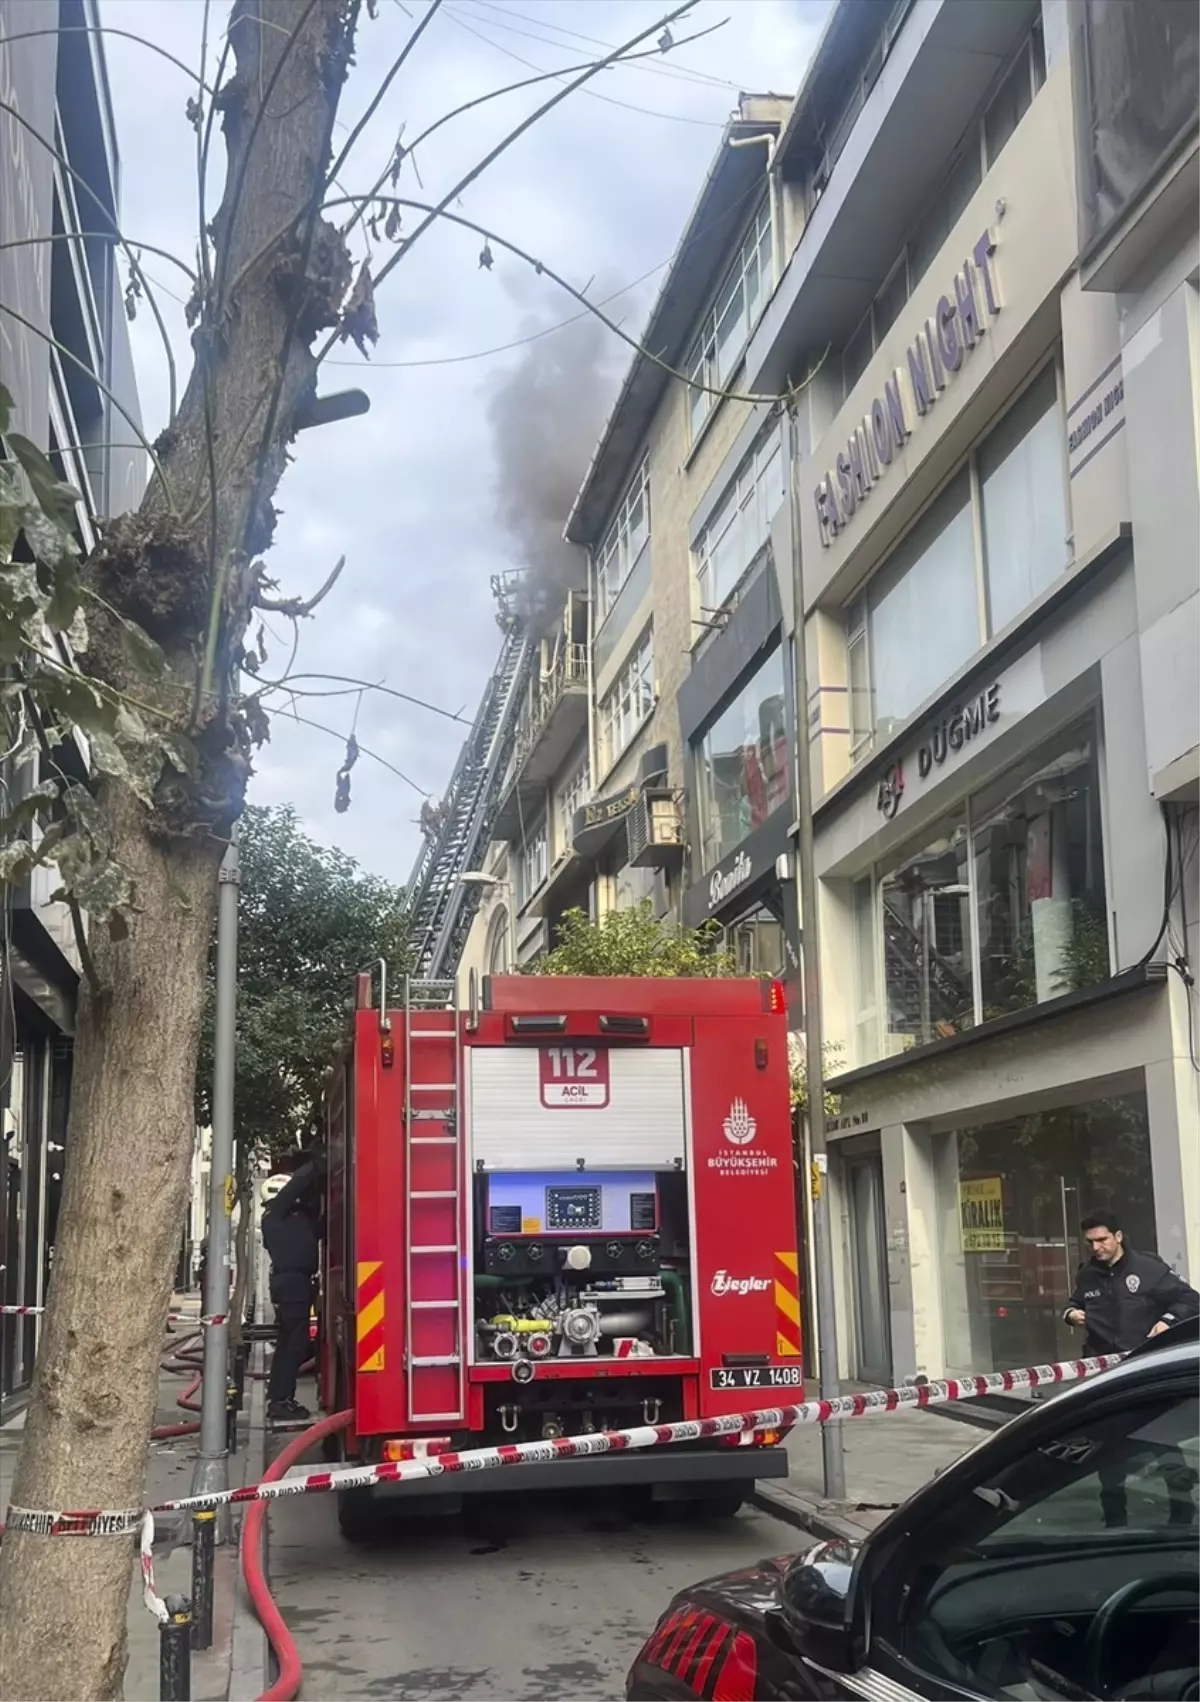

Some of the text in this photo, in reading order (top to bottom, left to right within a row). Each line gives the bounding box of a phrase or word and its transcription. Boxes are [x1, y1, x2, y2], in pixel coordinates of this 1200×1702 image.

[813, 227, 1004, 549] FASHION NIGHT
[548, 1047, 598, 1077] 112
[561, 1085, 588, 1097] ACİL
[718, 1149, 768, 1157] İSTANBUL
[707, 1156, 778, 1168] BÜYÜKŞEHİR
[720, 1168, 768, 1176] BELEDİYESİ
[711, 1269, 772, 1296] Ziegler
[718, 1367, 800, 1387] 34 VZ 1408
